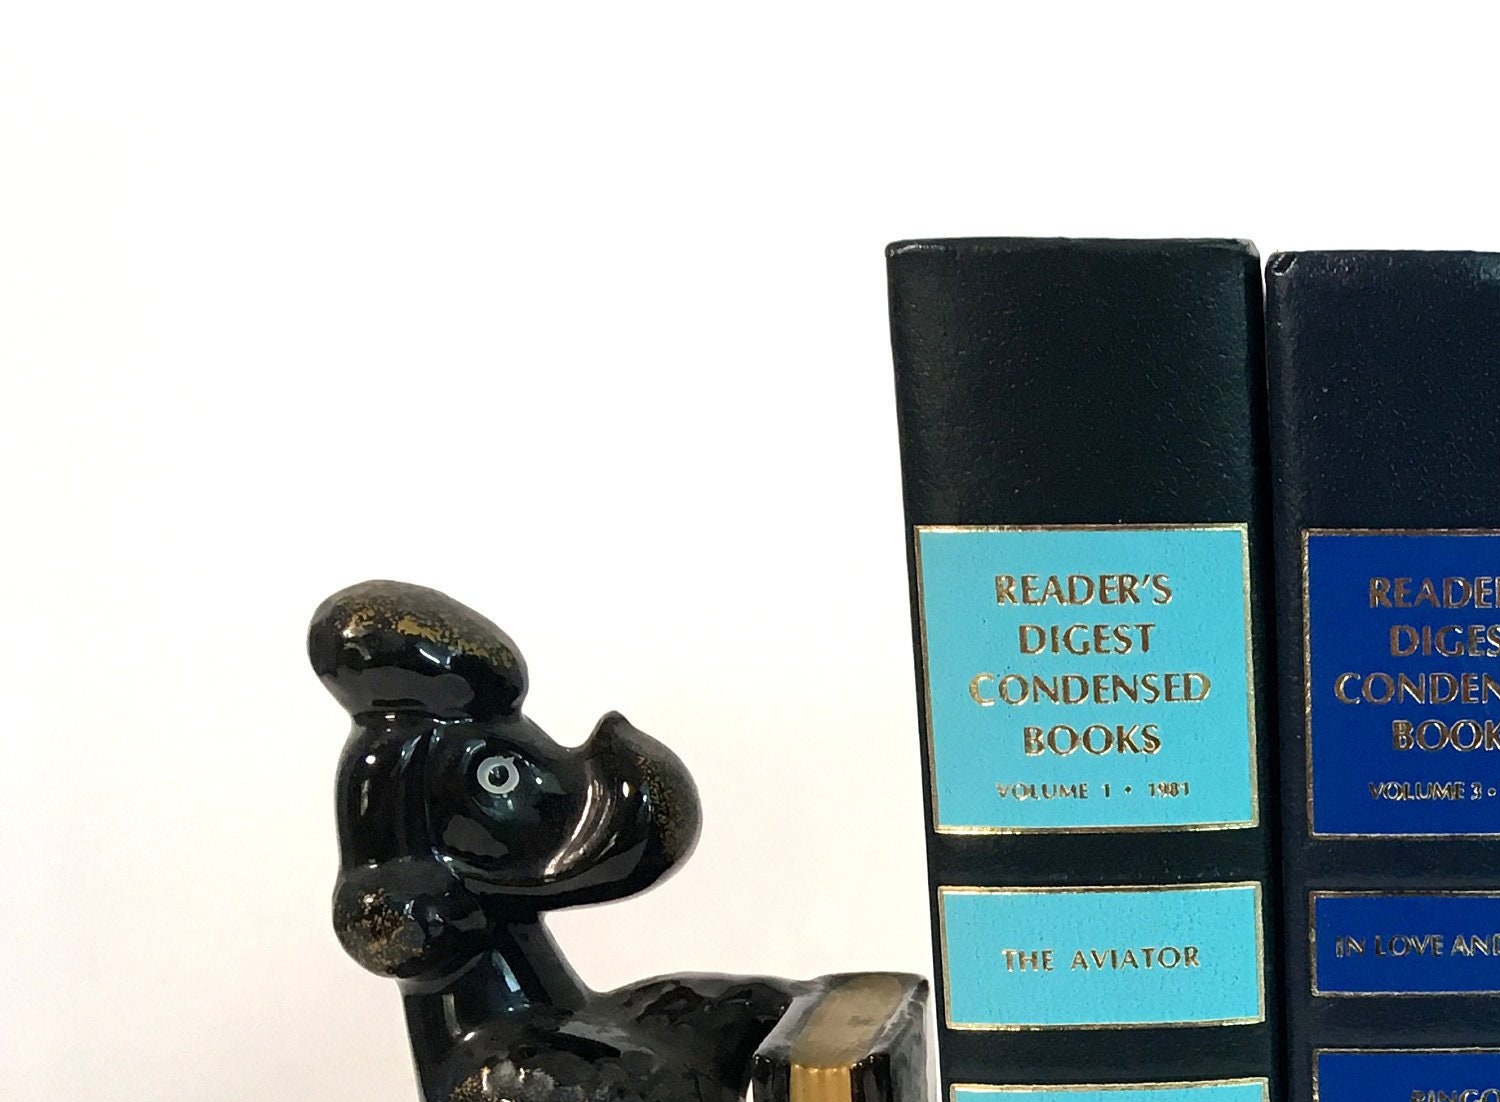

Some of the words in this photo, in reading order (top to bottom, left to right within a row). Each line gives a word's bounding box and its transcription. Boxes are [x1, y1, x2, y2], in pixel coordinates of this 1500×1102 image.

[995, 574, 1172, 605] READER'S
[1018, 624, 1156, 655] DIGEST
[969, 672, 1211, 706] CONDENSED
[1024, 724, 1161, 756] BOOKS
[997, 783, 1088, 801] VOLUME
[1102, 784, 1110, 798] 1
[1369, 782, 1464, 800] VOLUME
[1471, 782, 1482, 800] 3
[1001, 949, 1053, 972] THE
[1070, 946, 1200, 971] AVIATOR
[1336, 935, 1365, 958] IN
[1375, 935, 1443, 957] LOVE
